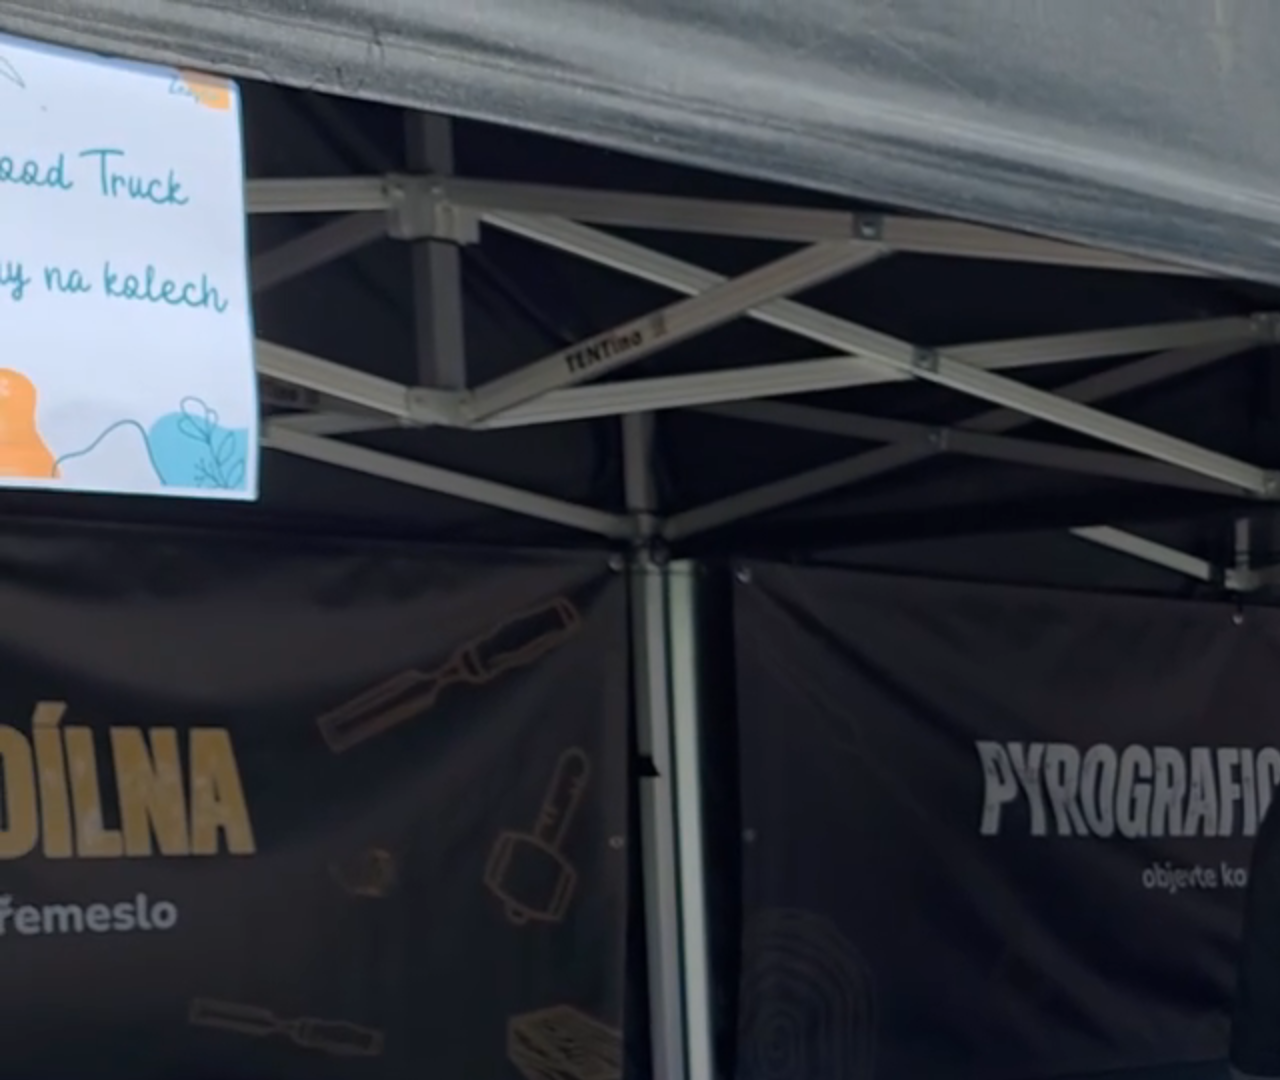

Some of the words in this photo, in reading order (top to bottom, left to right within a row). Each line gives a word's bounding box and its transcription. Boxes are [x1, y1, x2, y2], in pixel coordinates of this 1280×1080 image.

[79, 148, 190, 206] Truck
[44, 265, 91, 293] na
[103, 260, 228, 313] kolech
[1142, 862, 1218, 894] objevte
